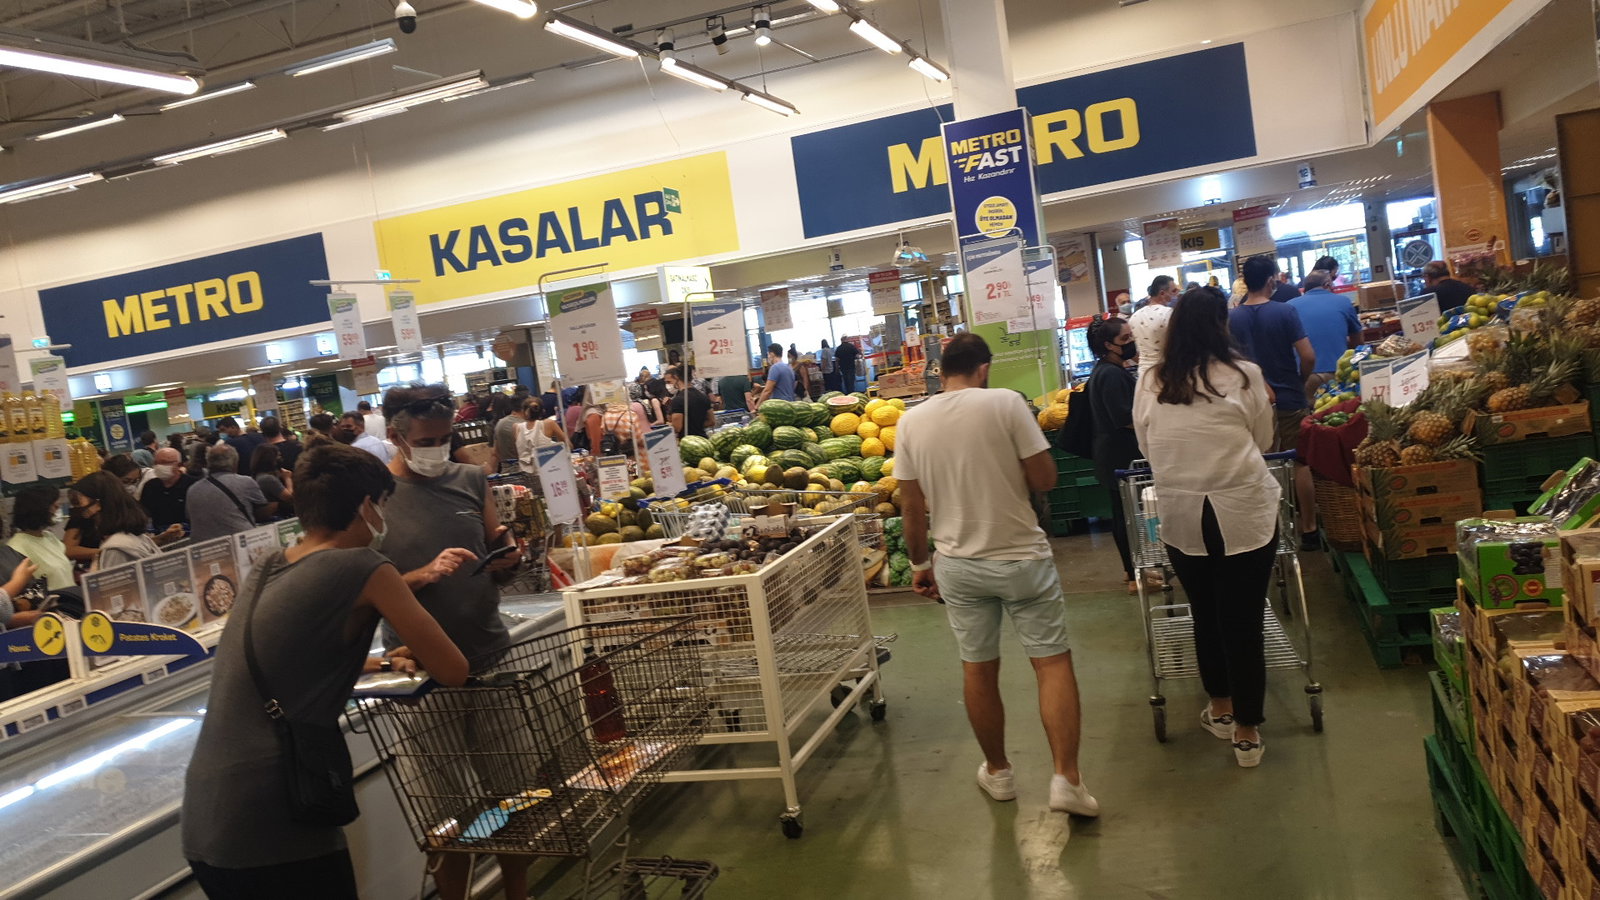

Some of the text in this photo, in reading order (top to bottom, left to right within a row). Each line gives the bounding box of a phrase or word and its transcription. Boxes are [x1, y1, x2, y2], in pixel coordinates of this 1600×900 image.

[888, 97, 1141, 193] MRO
[951, 128, 1021, 156] METRO
[961, 145, 1023, 173] FAST
[430, 190, 673, 277] KASALAR
[102, 270, 264, 338] METRO
